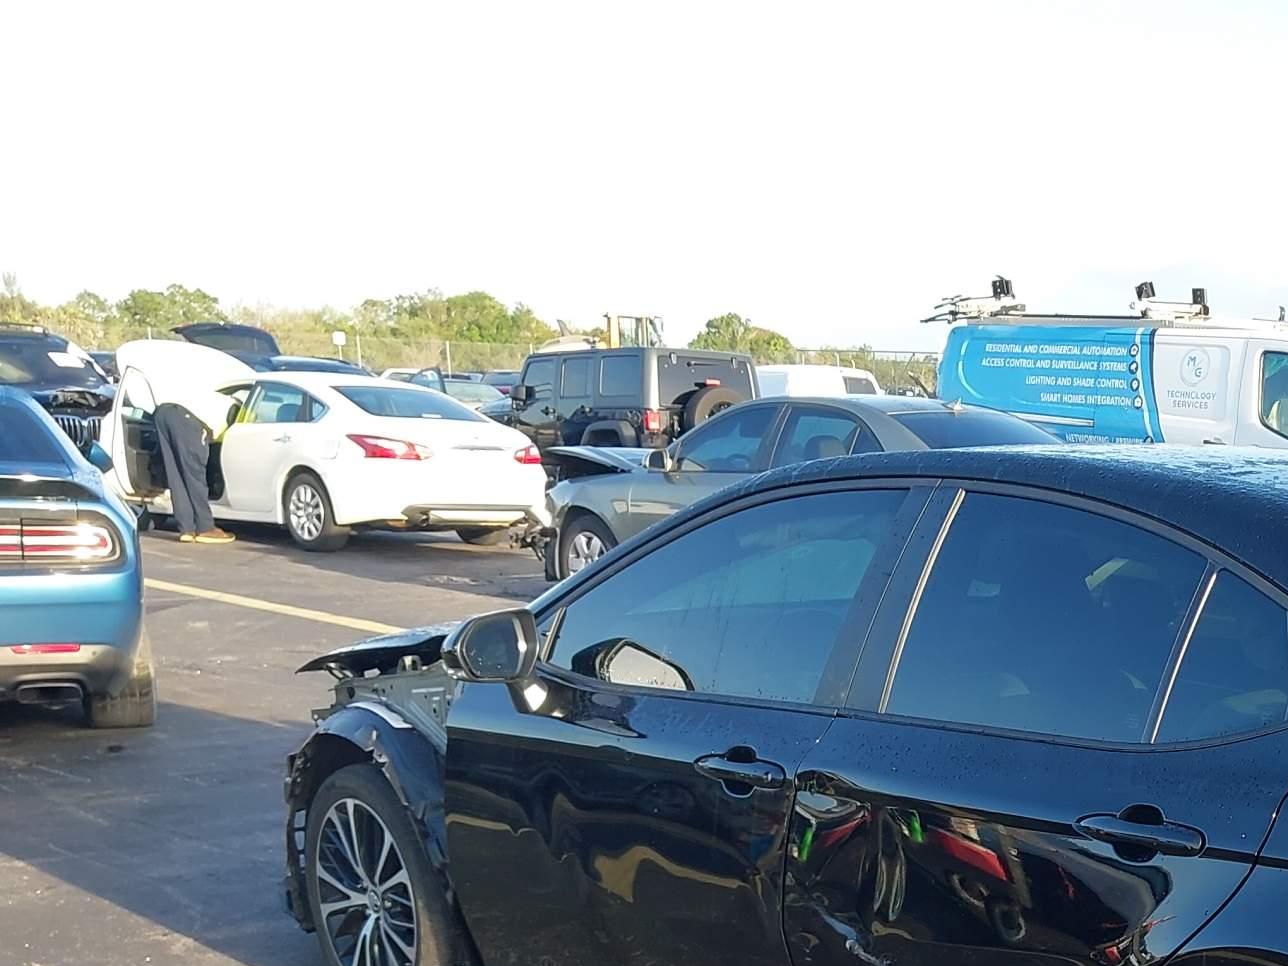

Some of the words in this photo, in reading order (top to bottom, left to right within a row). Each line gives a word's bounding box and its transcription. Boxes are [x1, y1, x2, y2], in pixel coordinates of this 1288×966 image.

[985, 343, 1022, 353] RESIDENTIAL
[1023, 344, 1038, 354] AND
[1039, 345, 1080, 355] COMMERCIAL
[1082, 346, 1127, 356] AUTOMATION
[981, 357, 1005, 367] ACCESS
[1005, 358, 1035, 369] CONTROL
[1036, 359, 1051, 369] AND
[1051, 360, 1097, 371] SURVEILLANCE
[1099, 361, 1127, 372] SYSTEMS
[1026, 376, 1056, 386] LIGHTING
[1057, 377, 1072, 387] AND
[1073, 378, 1095, 388] SHADE
[1096, 379, 1128, 390] CONTROL
[1040, 392, 1061, 403] SMART
[1062, 394, 1086, 404] HOMES
[1087, 395, 1132, 407] INTEGRATION
[1167, 390, 1217, 401] TECHNOLOGY
[1172, 400, 1209, 410] SERVICES
[1065, 432, 1109, 443] NETWORKING
